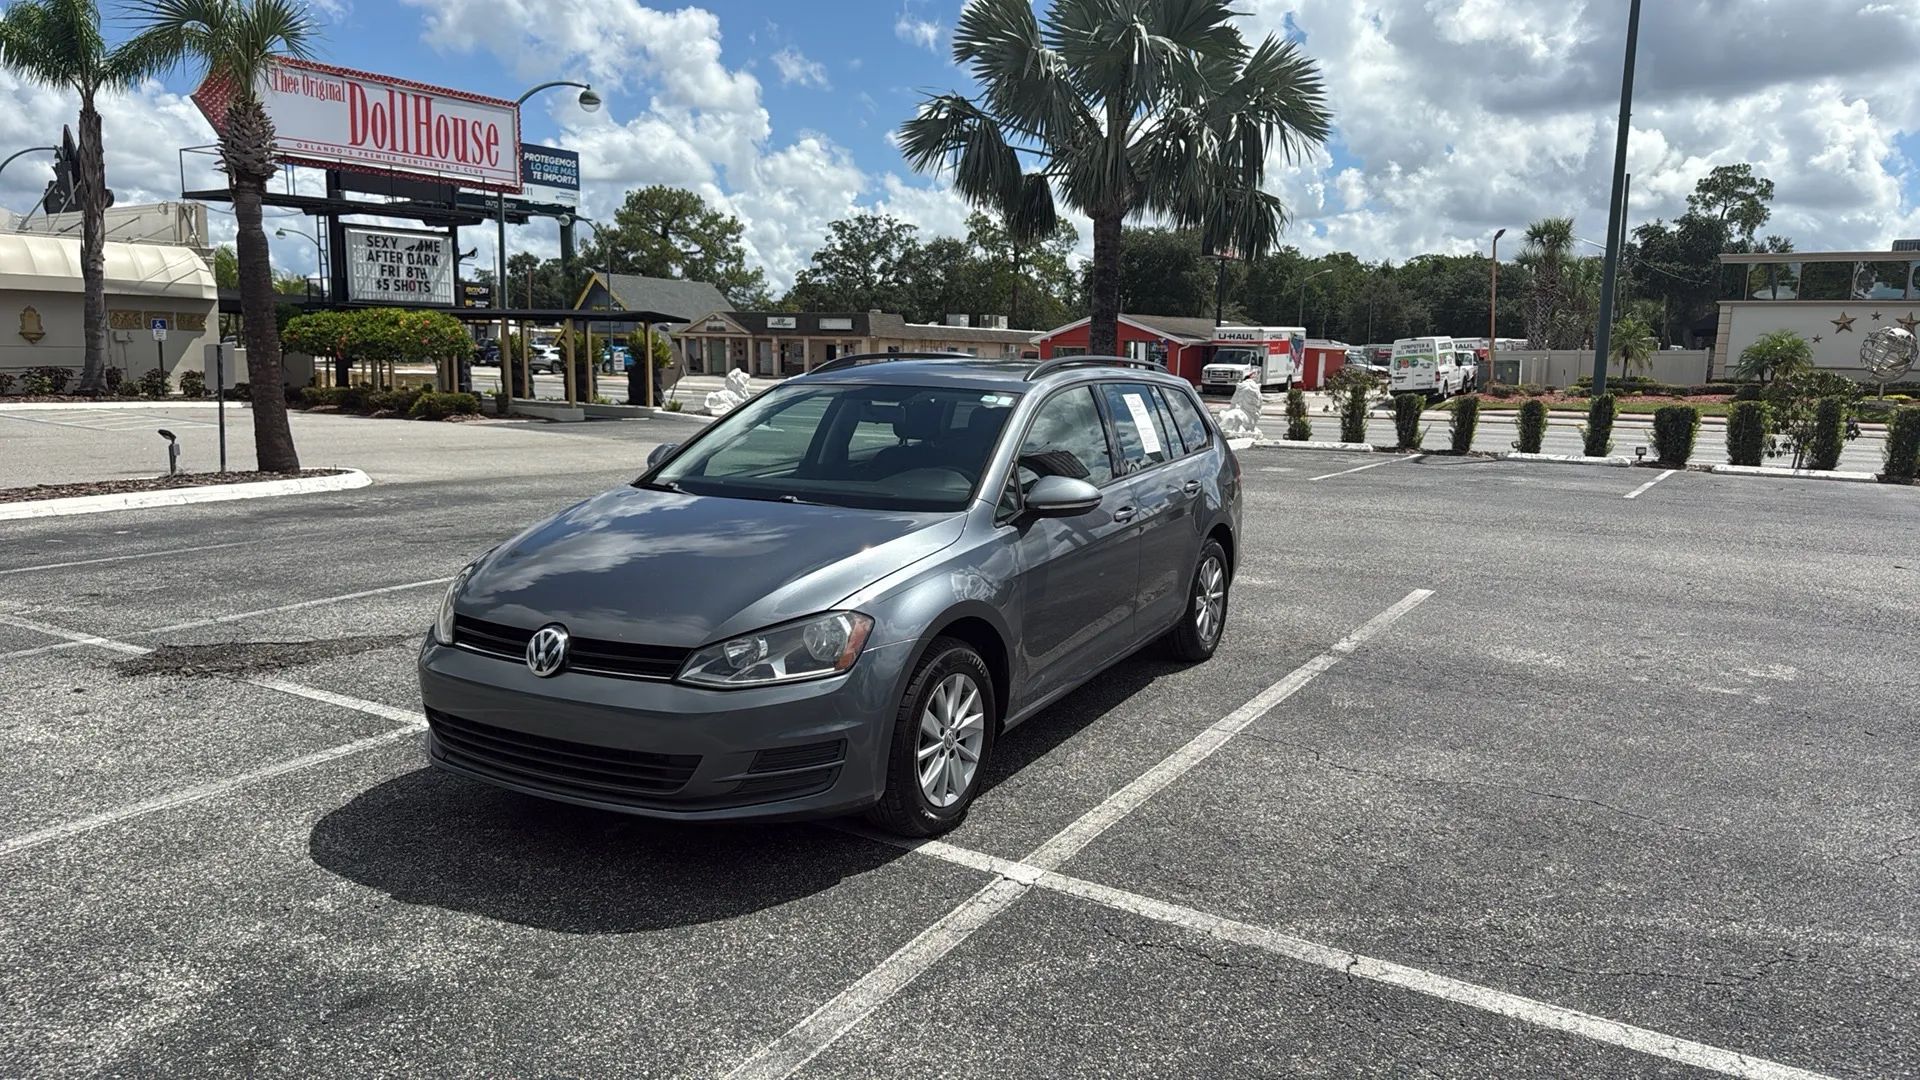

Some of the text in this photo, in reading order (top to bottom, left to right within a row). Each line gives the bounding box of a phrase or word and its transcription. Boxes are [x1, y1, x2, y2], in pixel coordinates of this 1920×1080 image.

[272, 67, 346, 103] Thee Original
[347, 81, 499, 167] DollHouse
[296, 142, 484, 175] ORLANDO'S PREMIER GENTLEMEN'S CLUB
[523, 152, 577, 168] PROTEGEMOS
[530, 162, 542, 171] LO
[543, 164, 559, 174] QUE
[532, 170, 577, 186] TE IMPORTA
[366, 235, 398, 249] SEXY
[366, 250, 438, 266] AFTER DARK
[380, 264, 428, 280] FRI 8TH
[376, 279, 431, 293] $5 SHOTS
